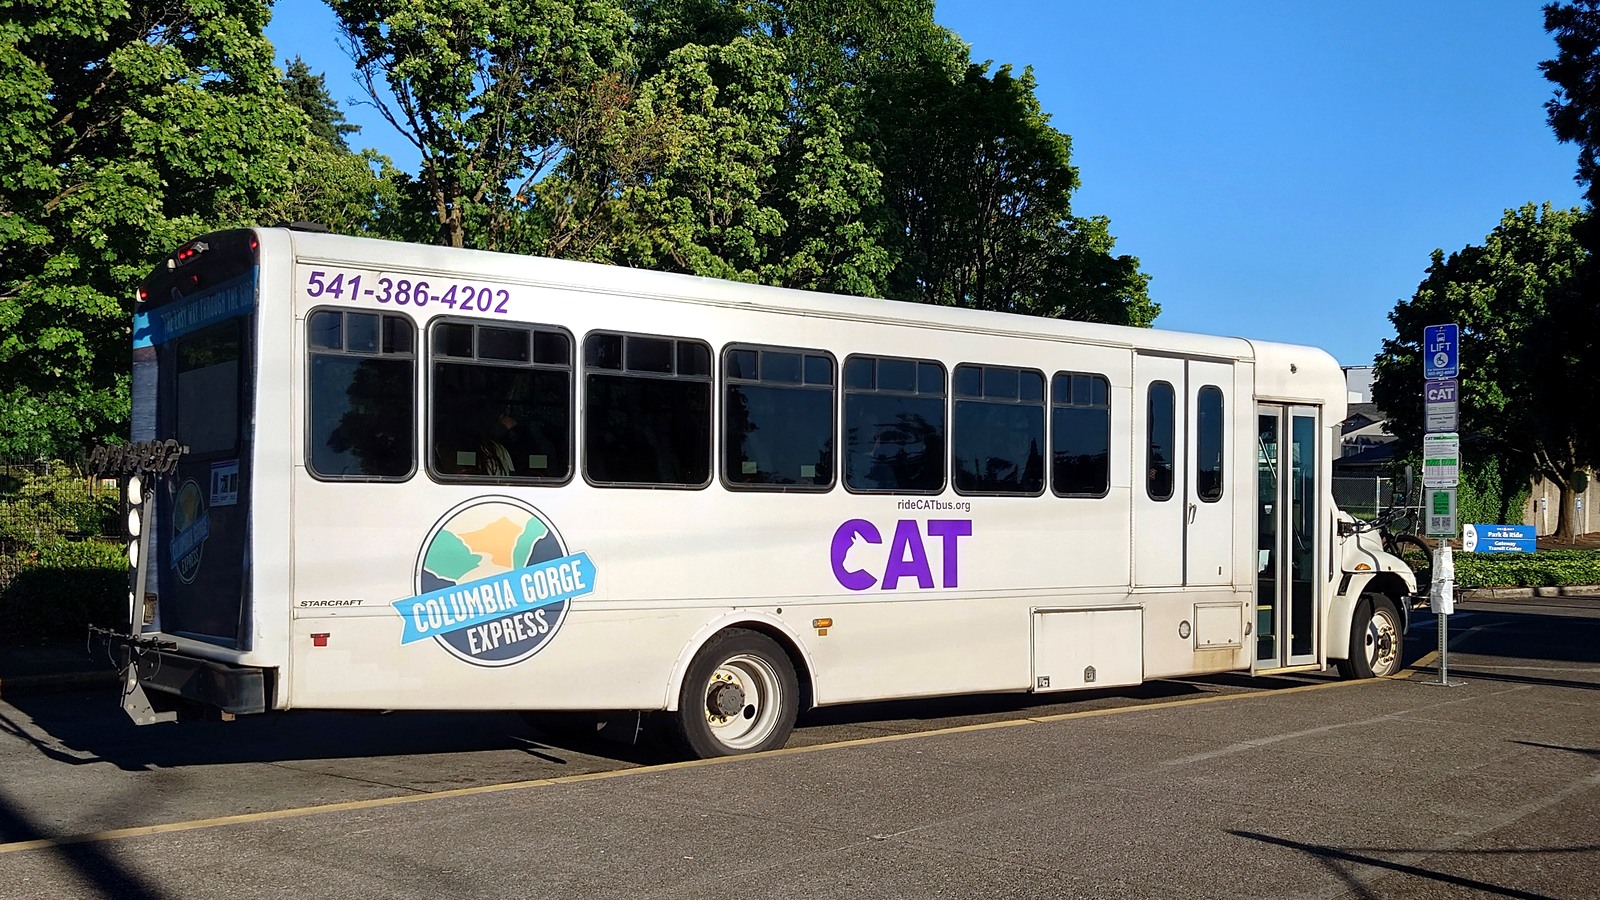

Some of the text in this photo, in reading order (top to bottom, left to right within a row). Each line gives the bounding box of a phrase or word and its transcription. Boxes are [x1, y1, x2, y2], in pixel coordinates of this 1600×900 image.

[306, 271, 510, 314] 541-386-4202
[1430, 342, 1452, 352] LIFT
[1428, 388, 1455, 400] CAT
[897, 499, 971, 512] rideCATbus.org
[830, 518, 972, 591] CAT
[300, 599, 364, 607] STARCRAFT
[412, 559, 586, 633] COLUMBIA GORGE
[466, 608, 549, 655] EXPRESS
